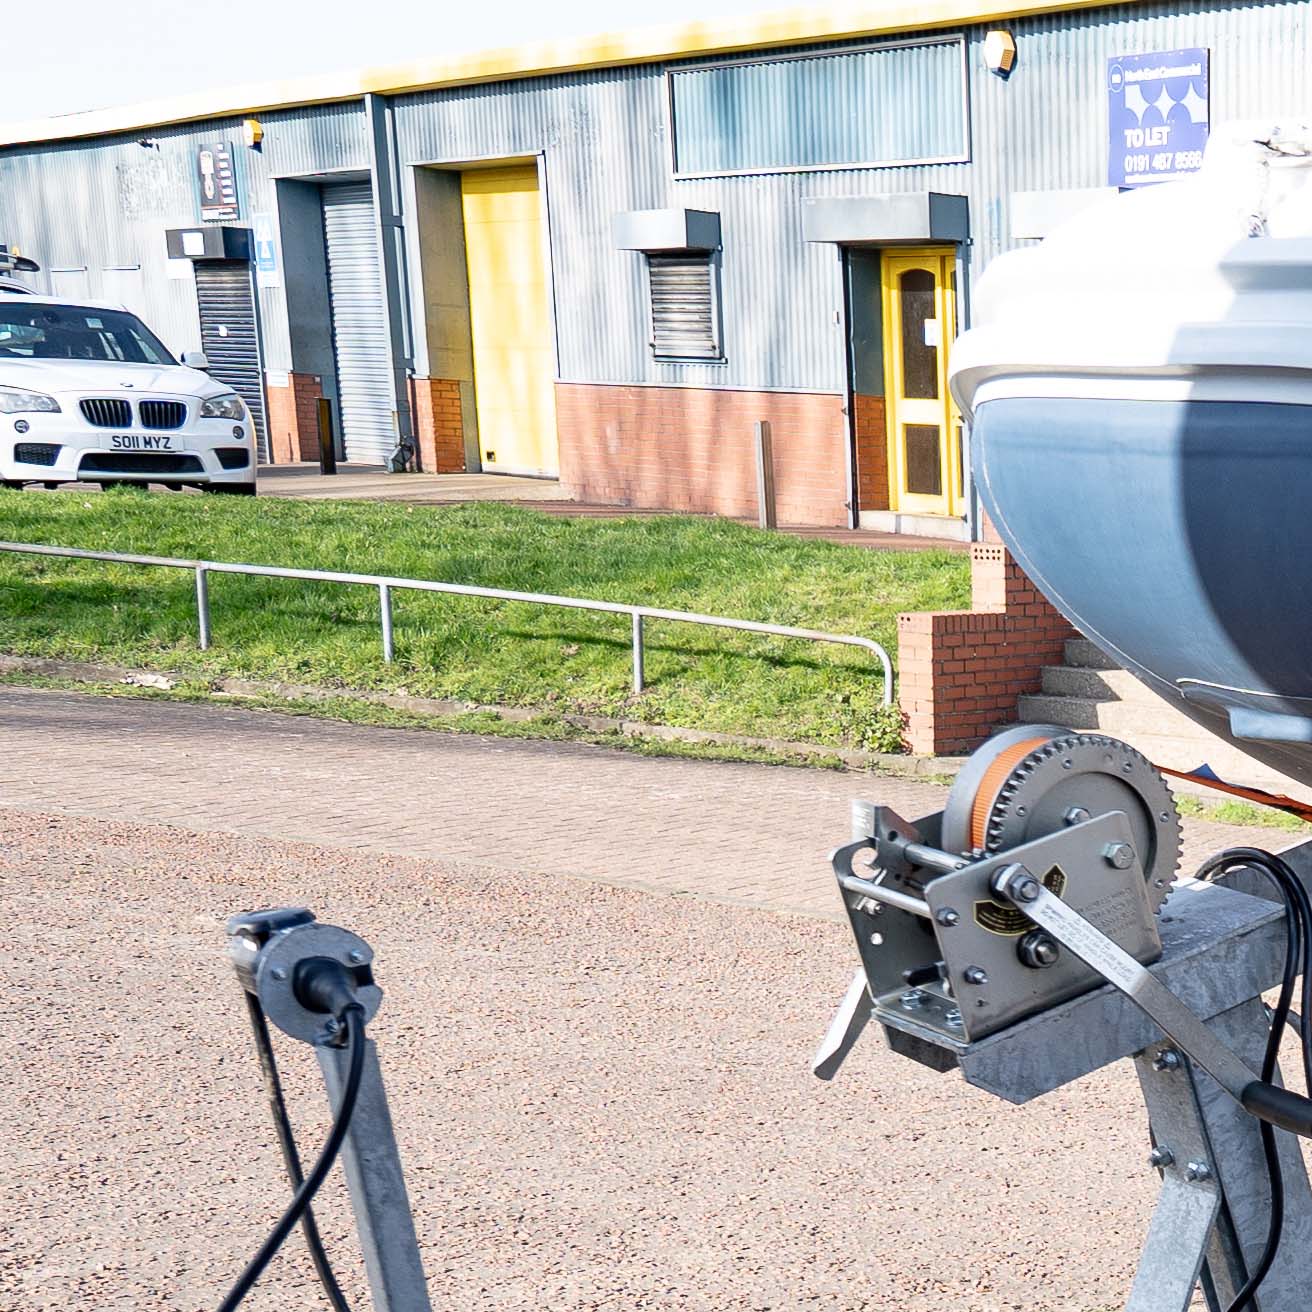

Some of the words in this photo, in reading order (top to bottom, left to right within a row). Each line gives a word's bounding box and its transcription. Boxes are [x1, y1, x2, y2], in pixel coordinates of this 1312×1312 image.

[1124, 127, 1144, 148] TO
[1145, 126, 1171, 146] LET
[1124, 153, 1149, 172] 0191
[112, 435, 140, 449] SO11
[143, 436, 172, 449] MYZ
